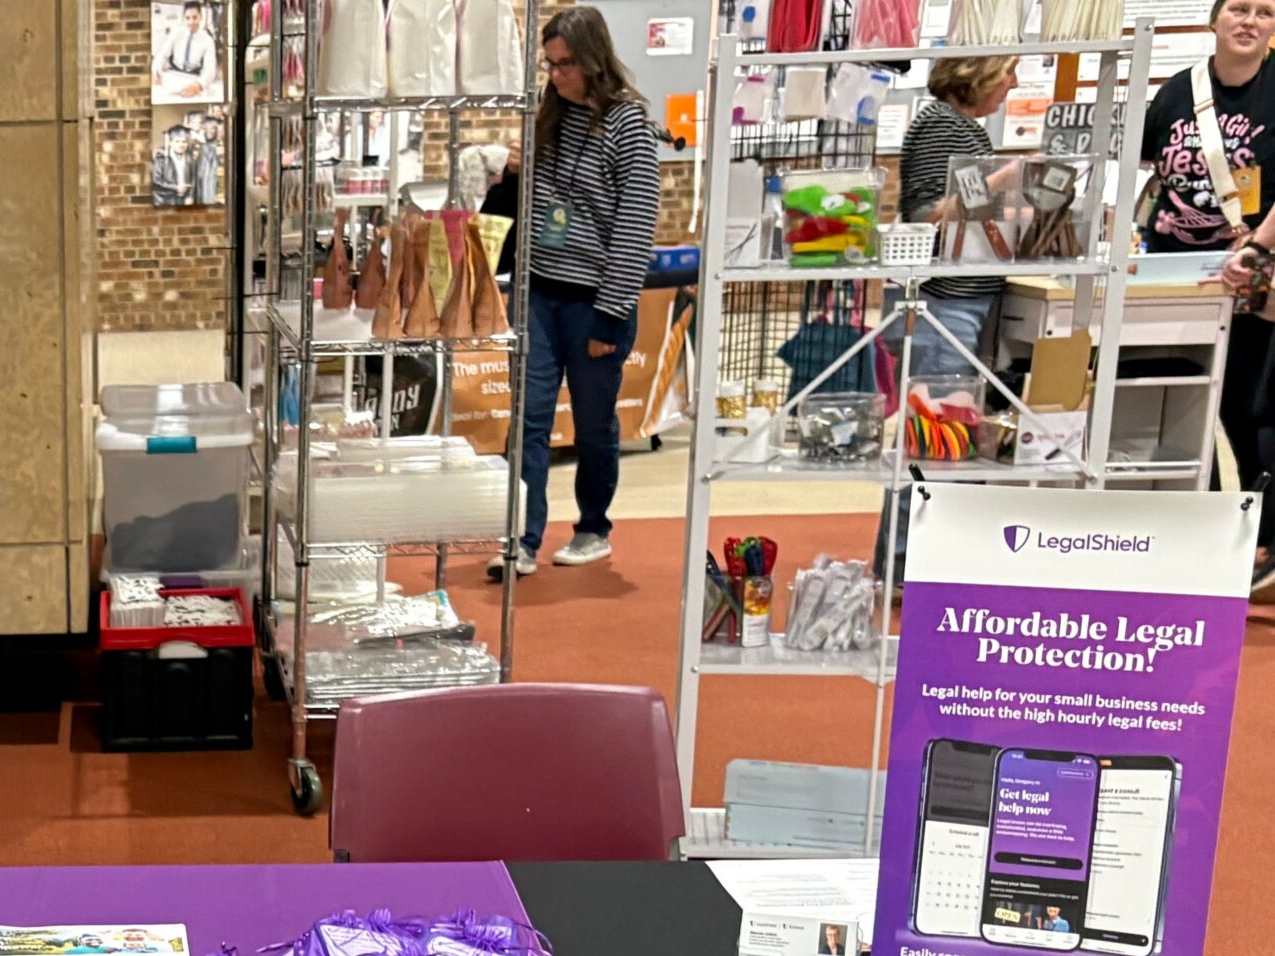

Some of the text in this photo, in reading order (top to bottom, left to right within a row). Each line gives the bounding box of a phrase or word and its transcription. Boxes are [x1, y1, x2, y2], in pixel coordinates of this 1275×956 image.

[453, 362, 478, 377] The
[936, 607, 1206, 652] Affordable Legal
[976, 638, 1158, 673] Protection!
[922, 684, 1206, 716] Legal help for your small business needs
[939, 702, 1183, 732] without the high hourly legal fees!
[998, 802, 1052, 816] help now
[999, 788, 1050, 803] Get legal
